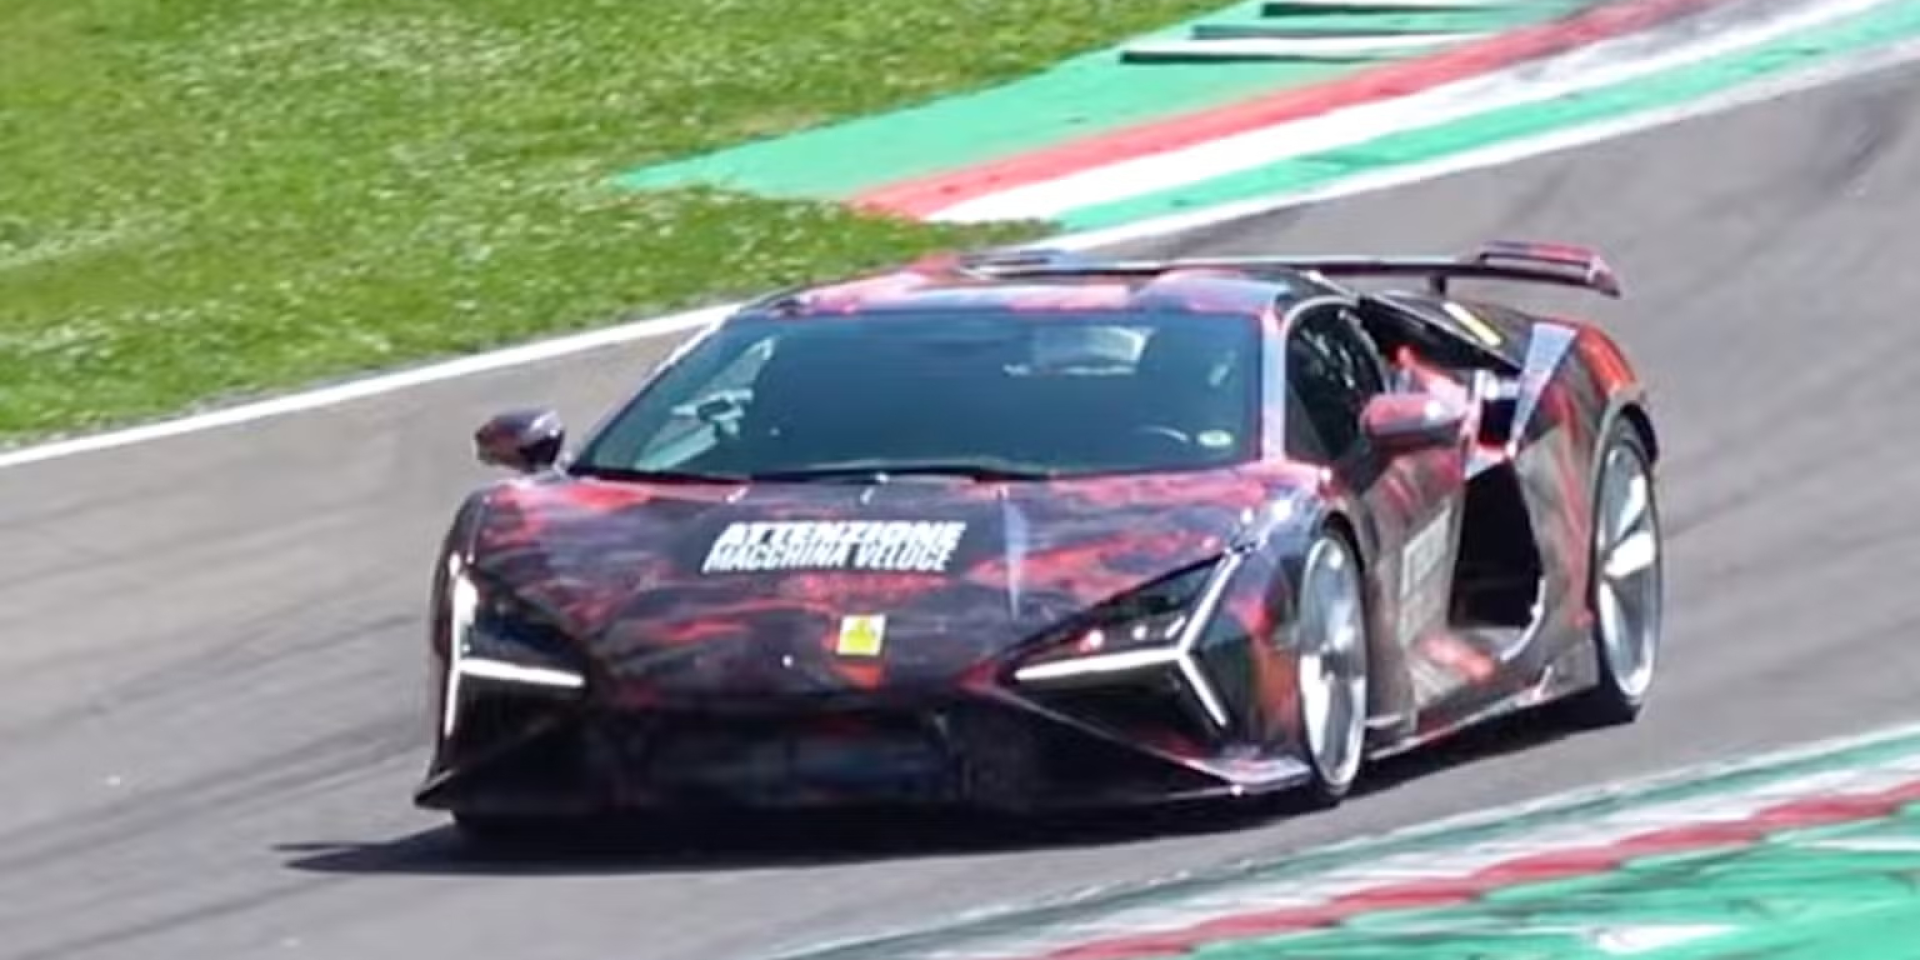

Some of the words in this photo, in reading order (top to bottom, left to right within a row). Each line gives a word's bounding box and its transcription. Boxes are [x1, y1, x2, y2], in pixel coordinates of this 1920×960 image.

[712, 521, 967, 549] ATTENZIONE
[702, 543, 851, 573] MACCHINA
[853, 543, 952, 572] VELOCE
